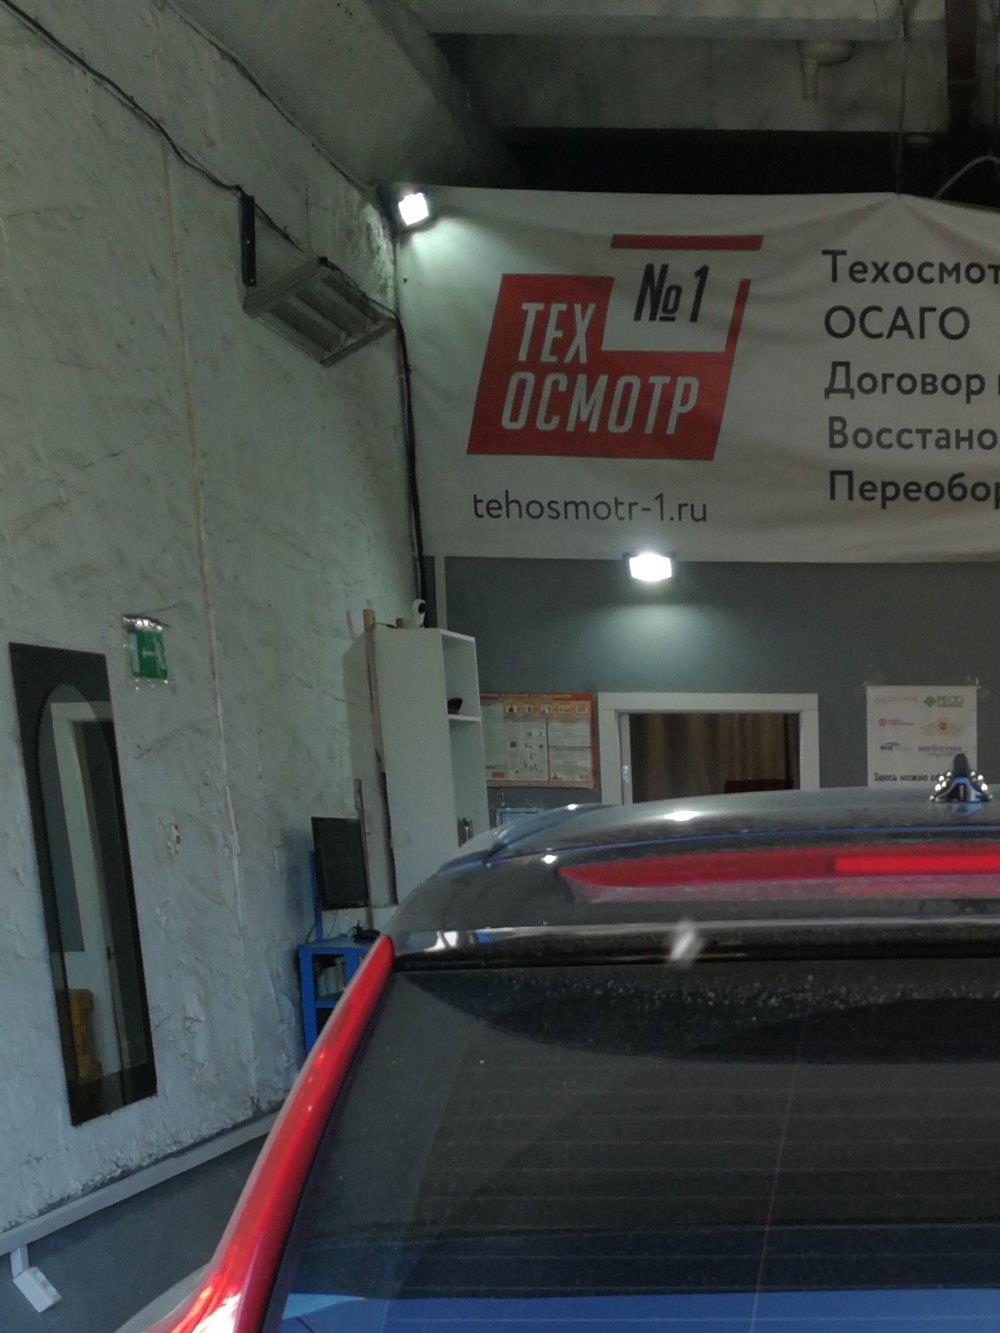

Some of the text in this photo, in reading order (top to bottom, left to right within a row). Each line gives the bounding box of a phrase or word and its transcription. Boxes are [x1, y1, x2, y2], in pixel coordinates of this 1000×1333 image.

[633, 262, 709, 323] №1
[517, 302, 597, 365] ТЕХ
[823, 305, 970, 341] ОСАГО
[501, 371, 701, 435] ОСМОТР
[824, 361, 986, 403] Договор
[473, 490, 708, 523] tehosmotr-1.ru
